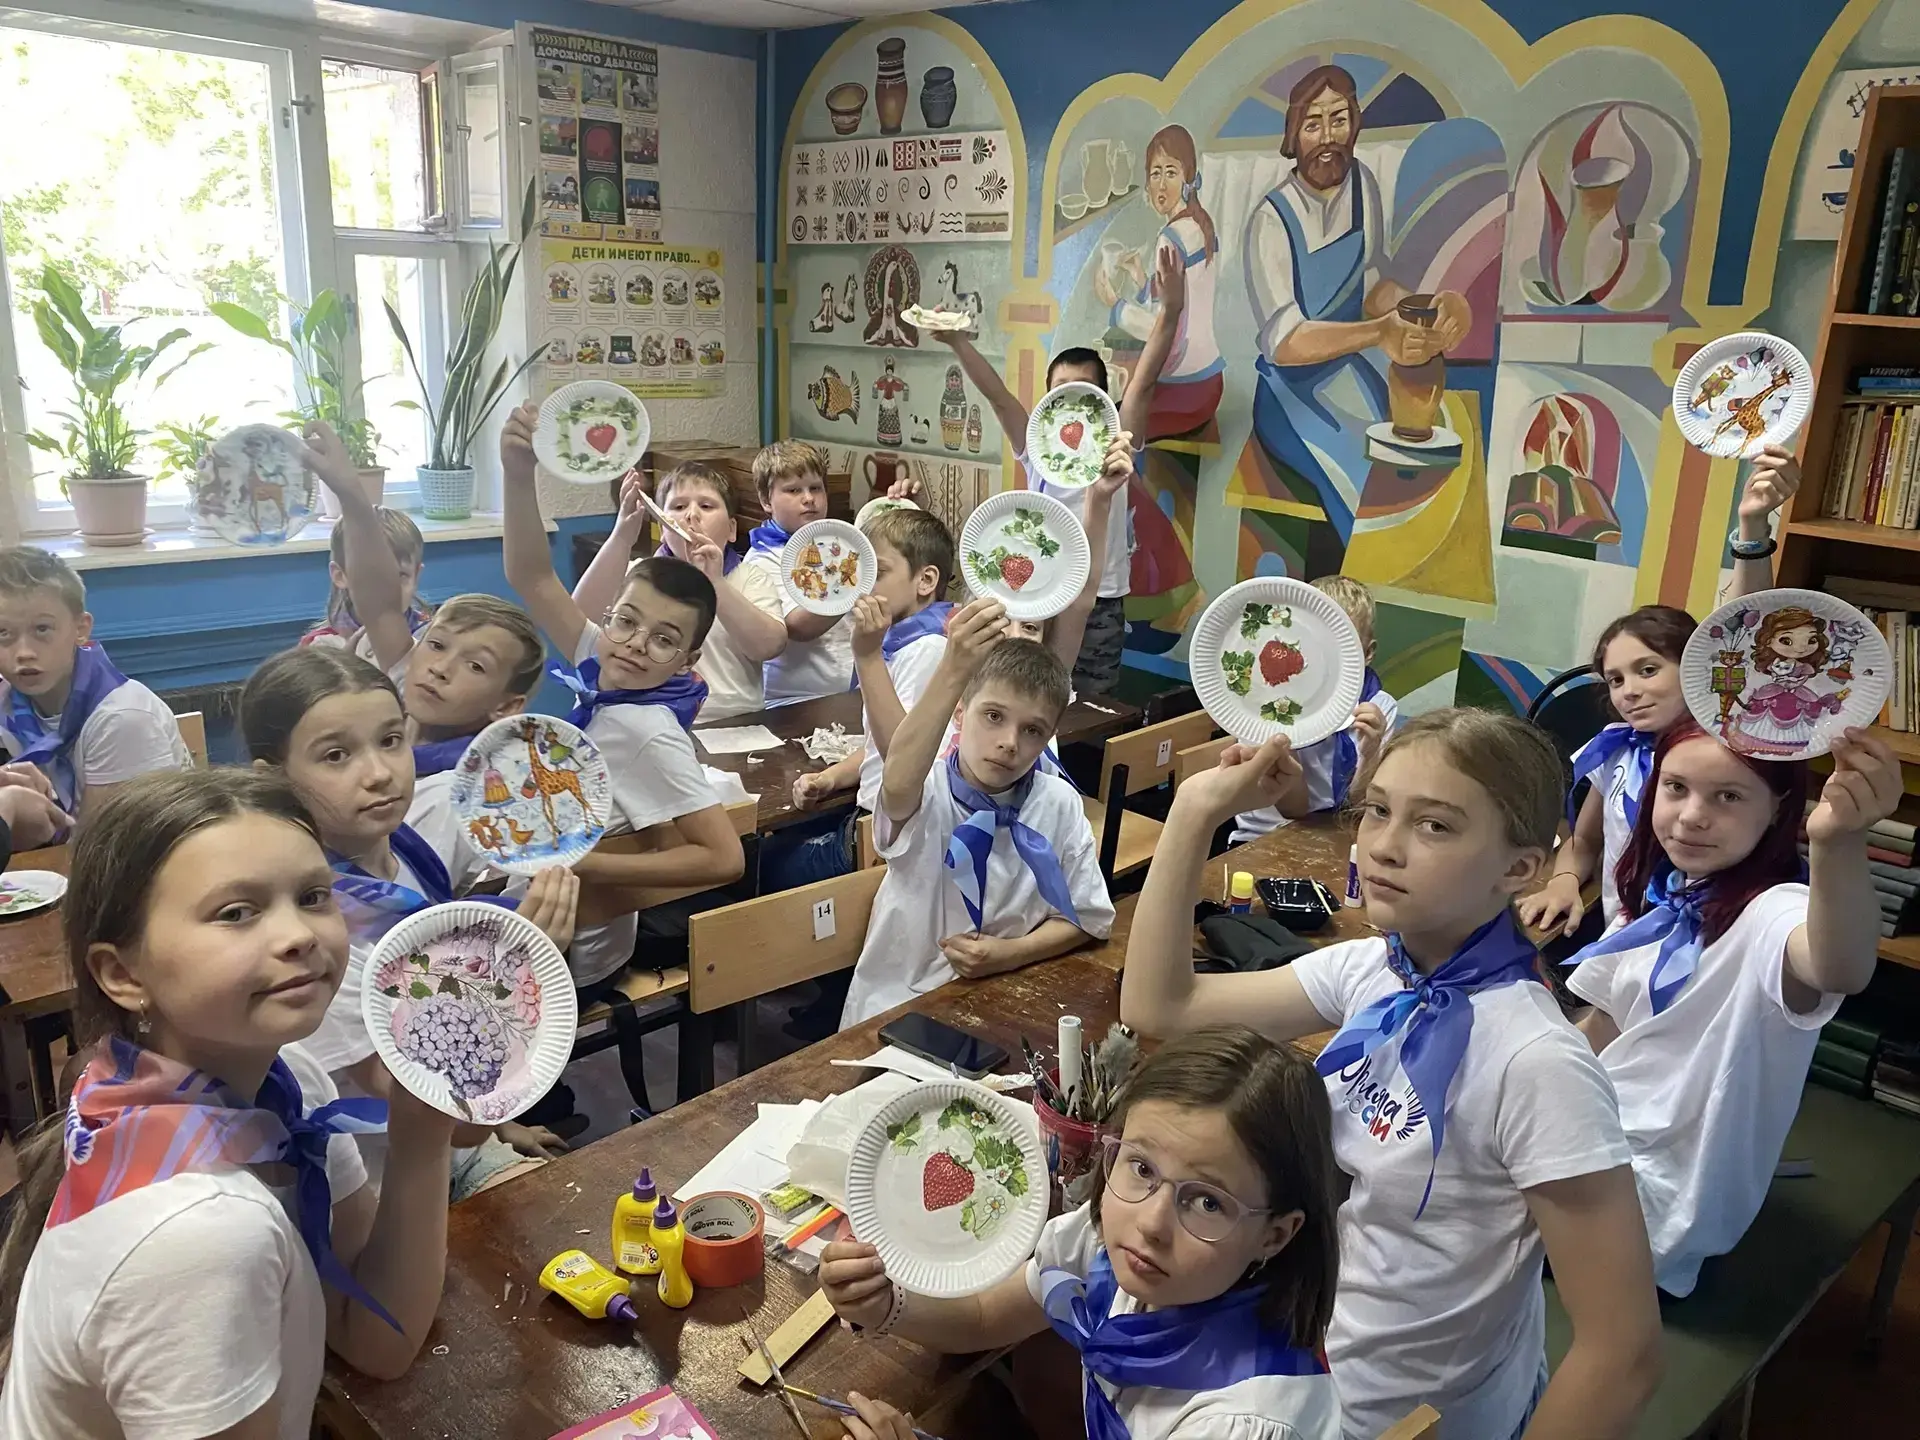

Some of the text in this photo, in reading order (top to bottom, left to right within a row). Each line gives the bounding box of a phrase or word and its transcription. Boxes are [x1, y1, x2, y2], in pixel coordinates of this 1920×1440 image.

[568, 36, 628, 58] ПРАВИЛА
[536, 46, 657, 74] ДОРОЖНОГО ДВИЖЕНИЯ
[572, 246, 700, 264] ДЕТИ ИМЕЮТ ПРАВО...
[818, 903, 830, 918] 14
